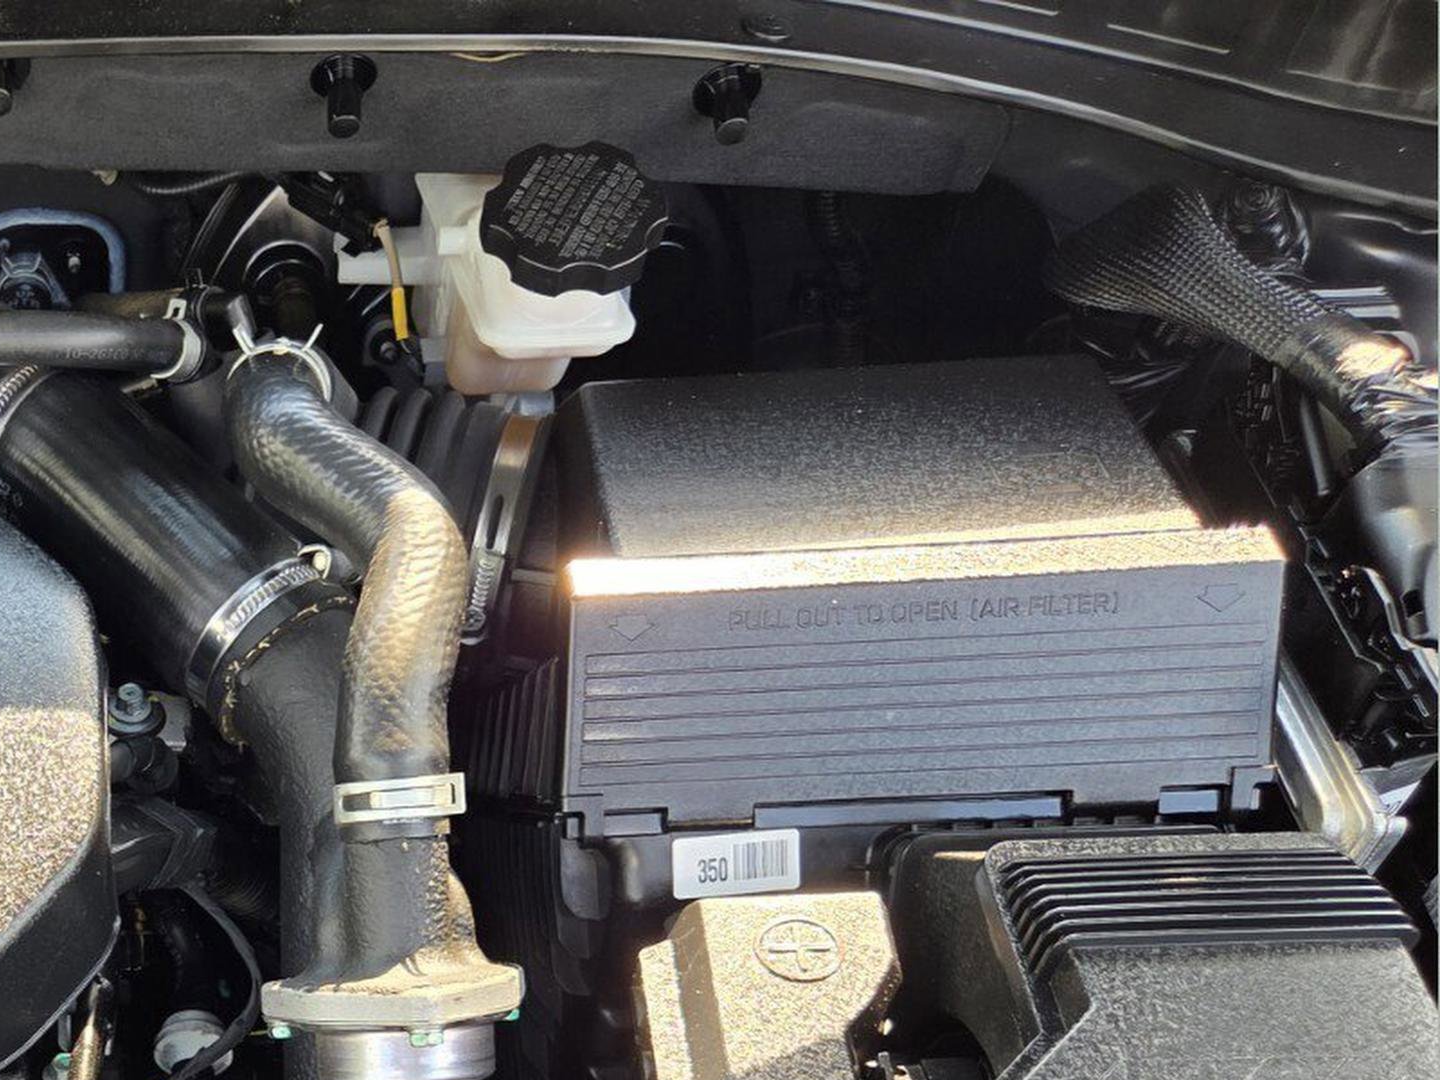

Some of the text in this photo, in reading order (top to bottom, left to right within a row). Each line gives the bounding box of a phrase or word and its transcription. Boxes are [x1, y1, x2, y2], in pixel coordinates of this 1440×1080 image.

[728, 591, 1120, 632] PULL OUT TO OPEN (AIR FILTER)
[697, 857, 728, 883] 350
